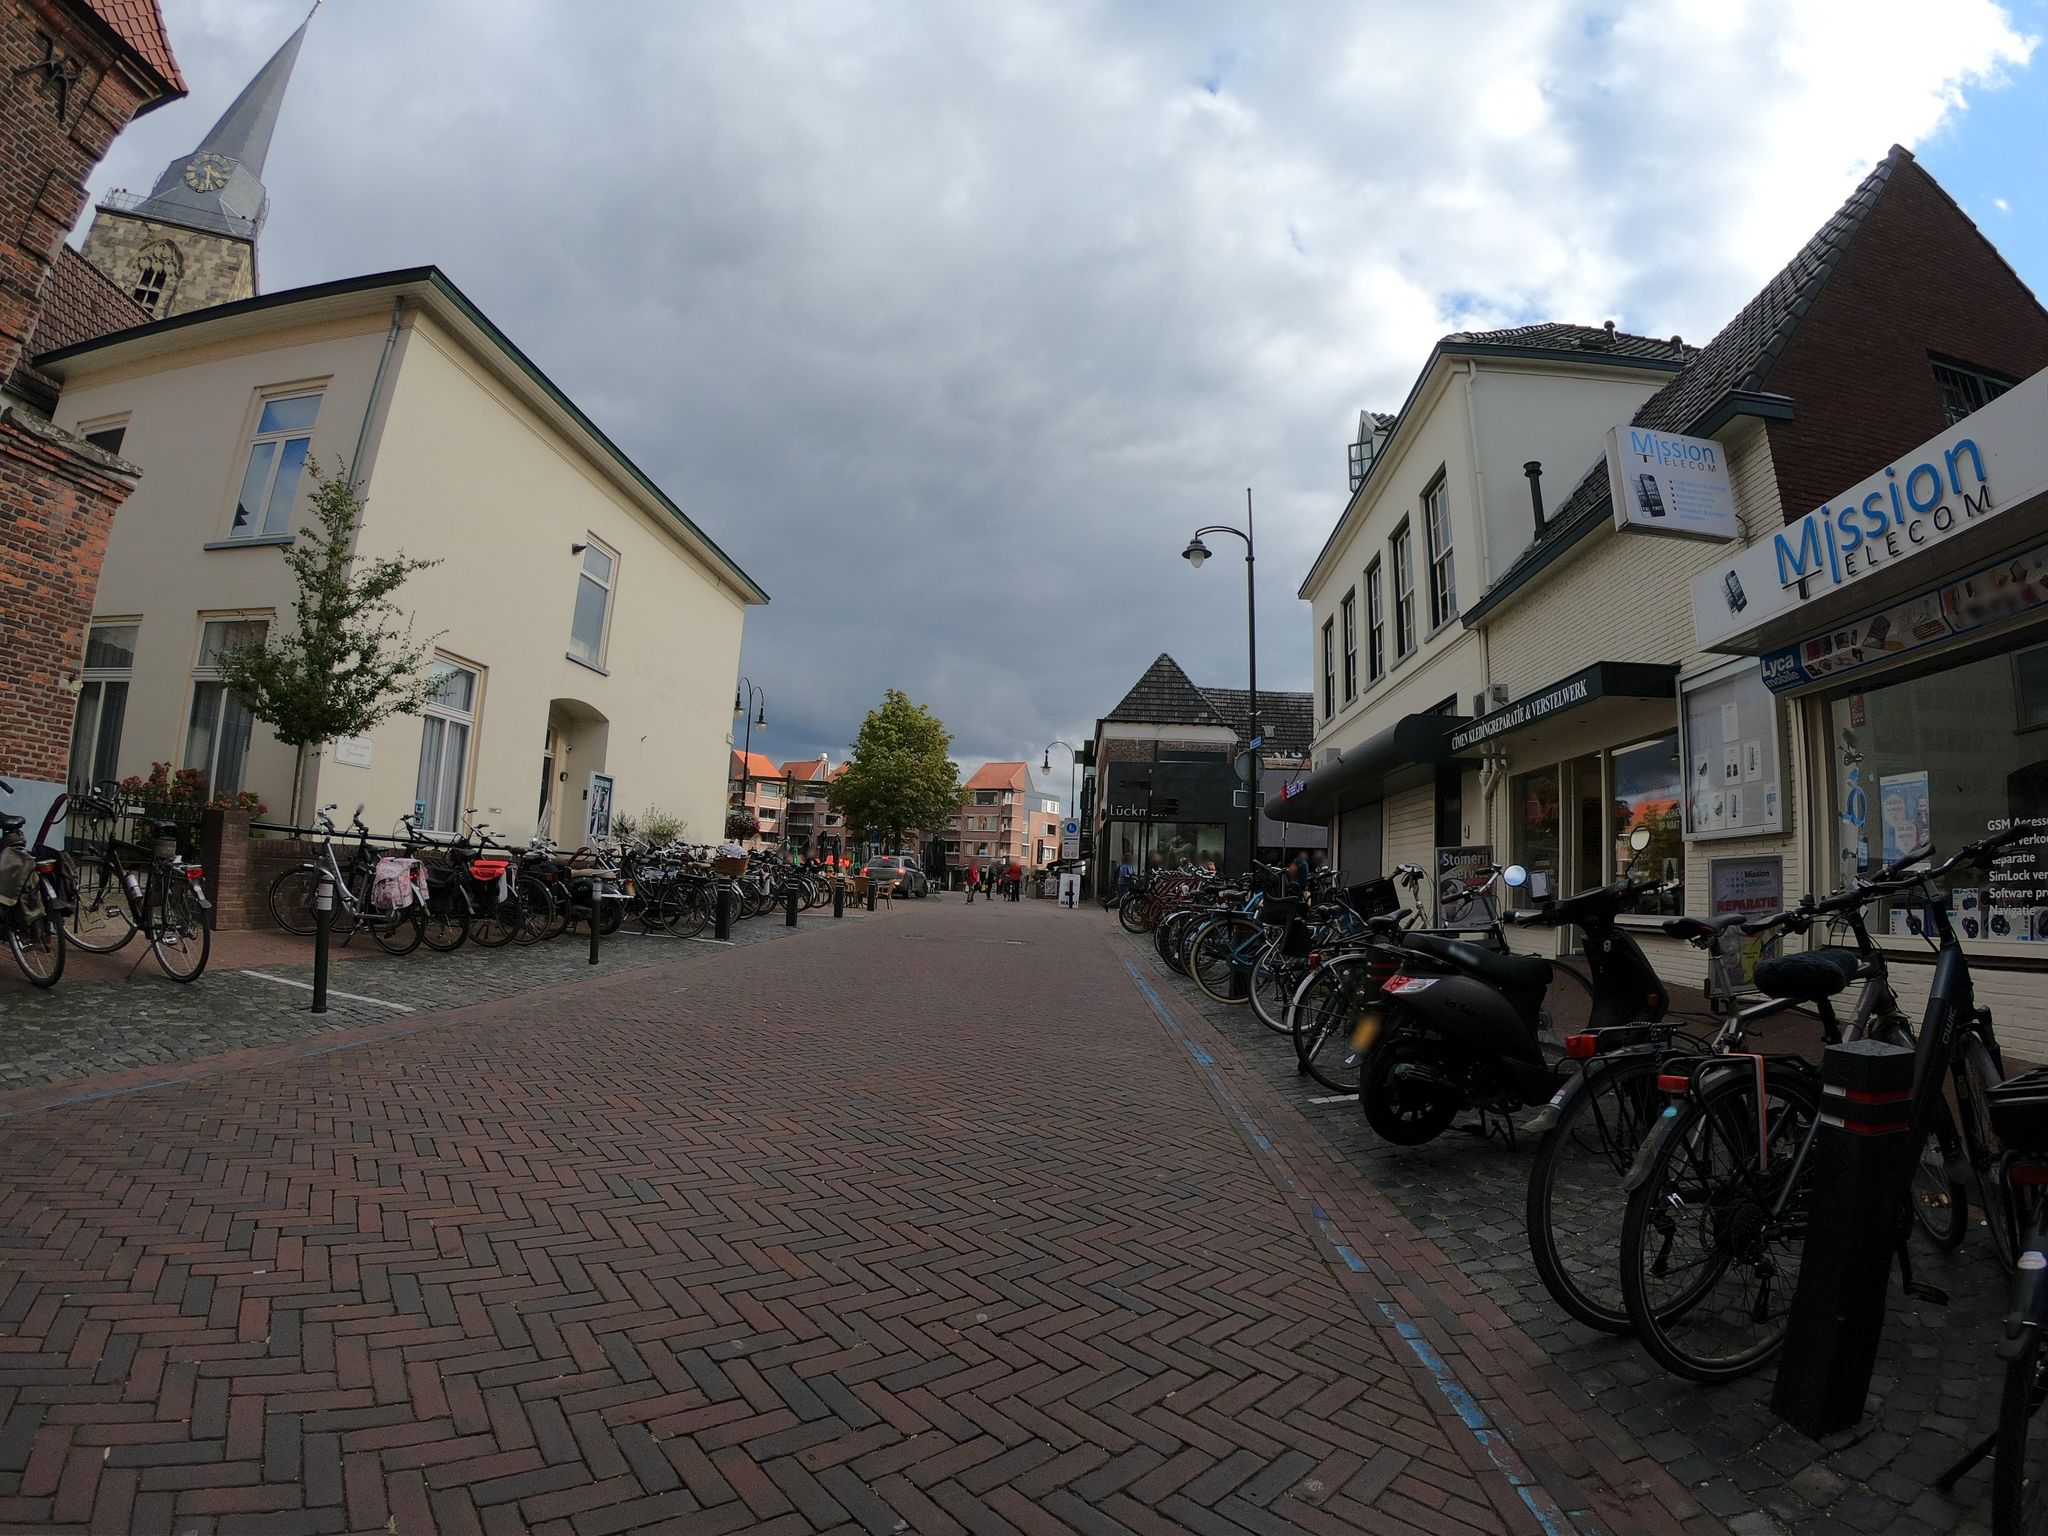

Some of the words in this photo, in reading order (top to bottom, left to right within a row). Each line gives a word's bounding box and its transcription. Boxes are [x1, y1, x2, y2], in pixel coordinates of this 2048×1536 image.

[1631, 431, 1715, 465] Mission
[1773, 438, 1987, 584] Mission
[1761, 654, 1795, 678] Lyca
[1765, 670, 1800, 688] mobile
[1525, 704, 1532, 720] &
[1531, 679, 1588, 717] VERSTELWERK
[1987, 818, 2011, 831] GSM
[2018, 833, 2048, 846] verko
[1443, 851, 1489, 867] Stomerij
[1744, 869, 1770, 879] Mission
[1988, 869, 2031, 882] SimLock
[1988, 887, 2033, 899] Software
[1717, 896, 1778, 912] REPARATIE
[1989, 904, 2036, 919] Navigatie
